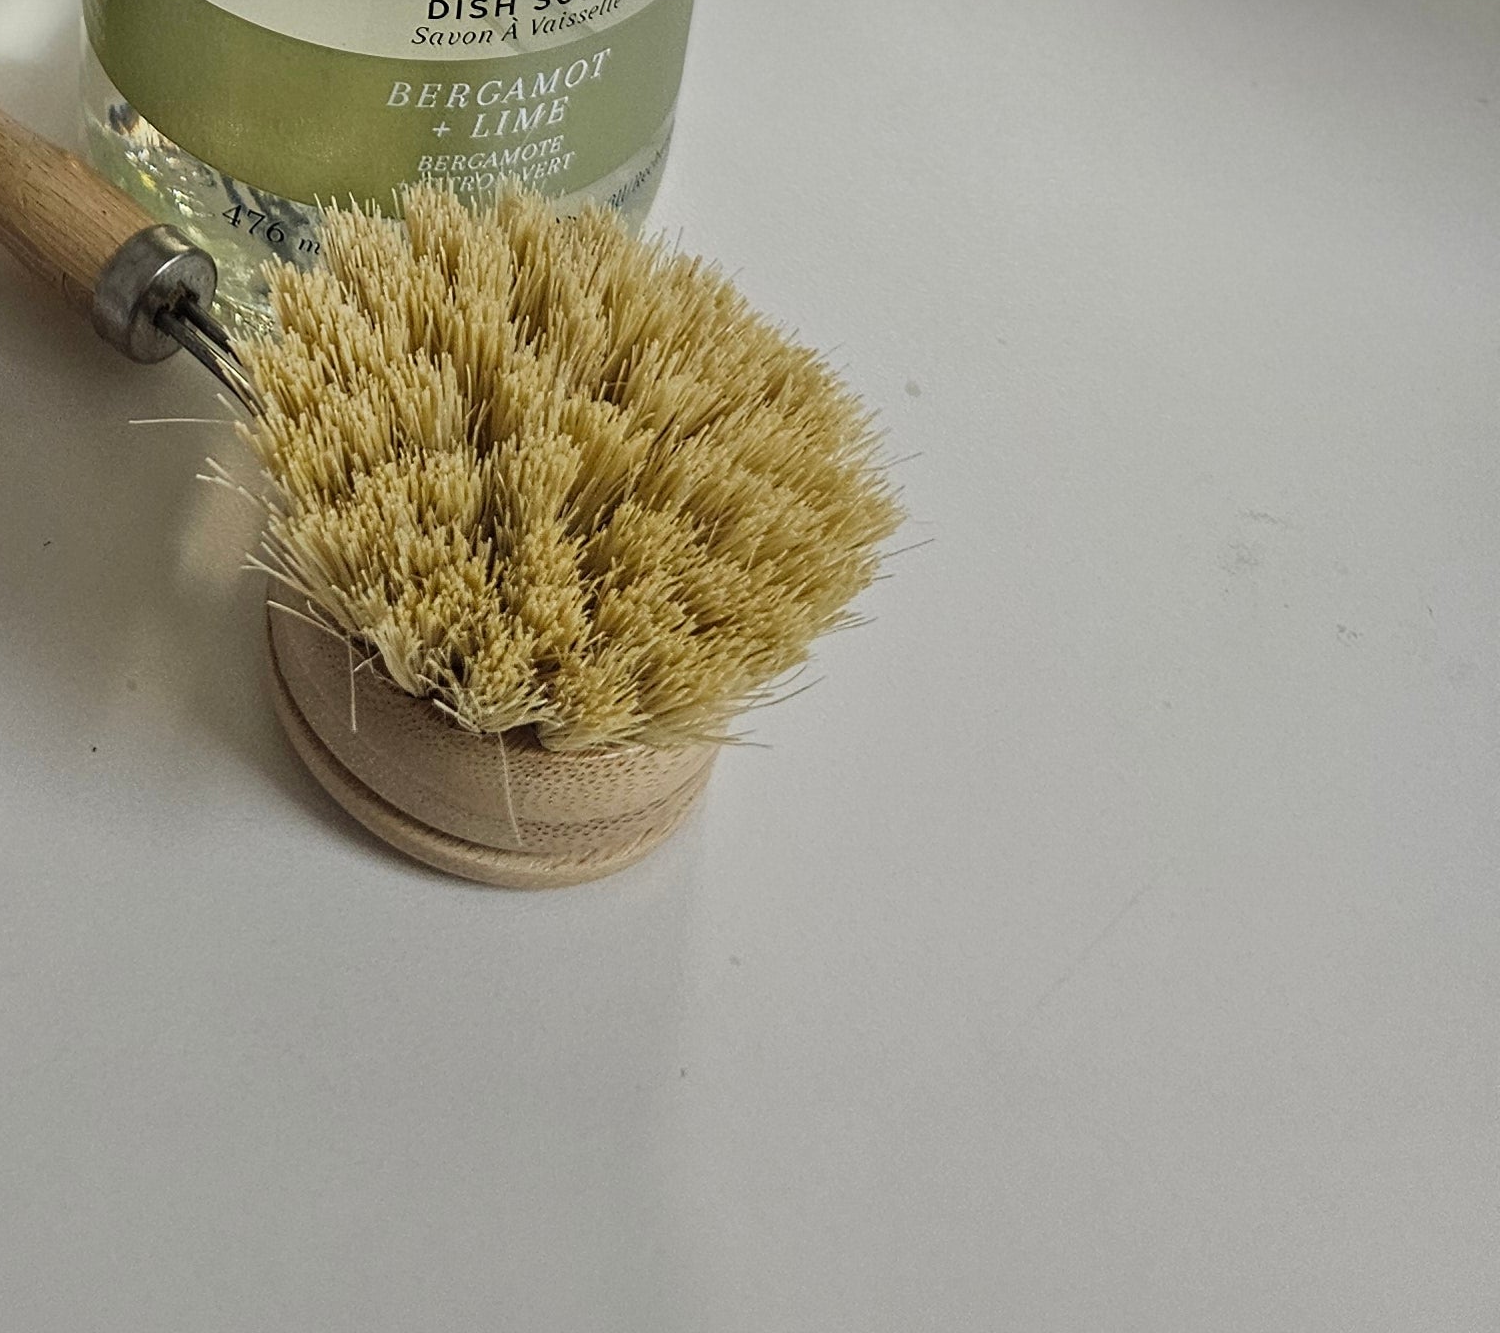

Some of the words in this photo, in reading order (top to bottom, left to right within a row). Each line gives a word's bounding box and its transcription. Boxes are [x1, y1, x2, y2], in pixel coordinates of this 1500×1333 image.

[411, 26, 493, 46] Savon
[501, 17, 518, 42] À
[386, 47, 611, 109] BERGAMOT
[432, 120, 451, 138] +
[469, 96, 569, 139] LIME
[417, 135, 564, 172] BERGAMOTE
[521, 151, 576, 183] VERT
[222, 204, 285, 244] 476
